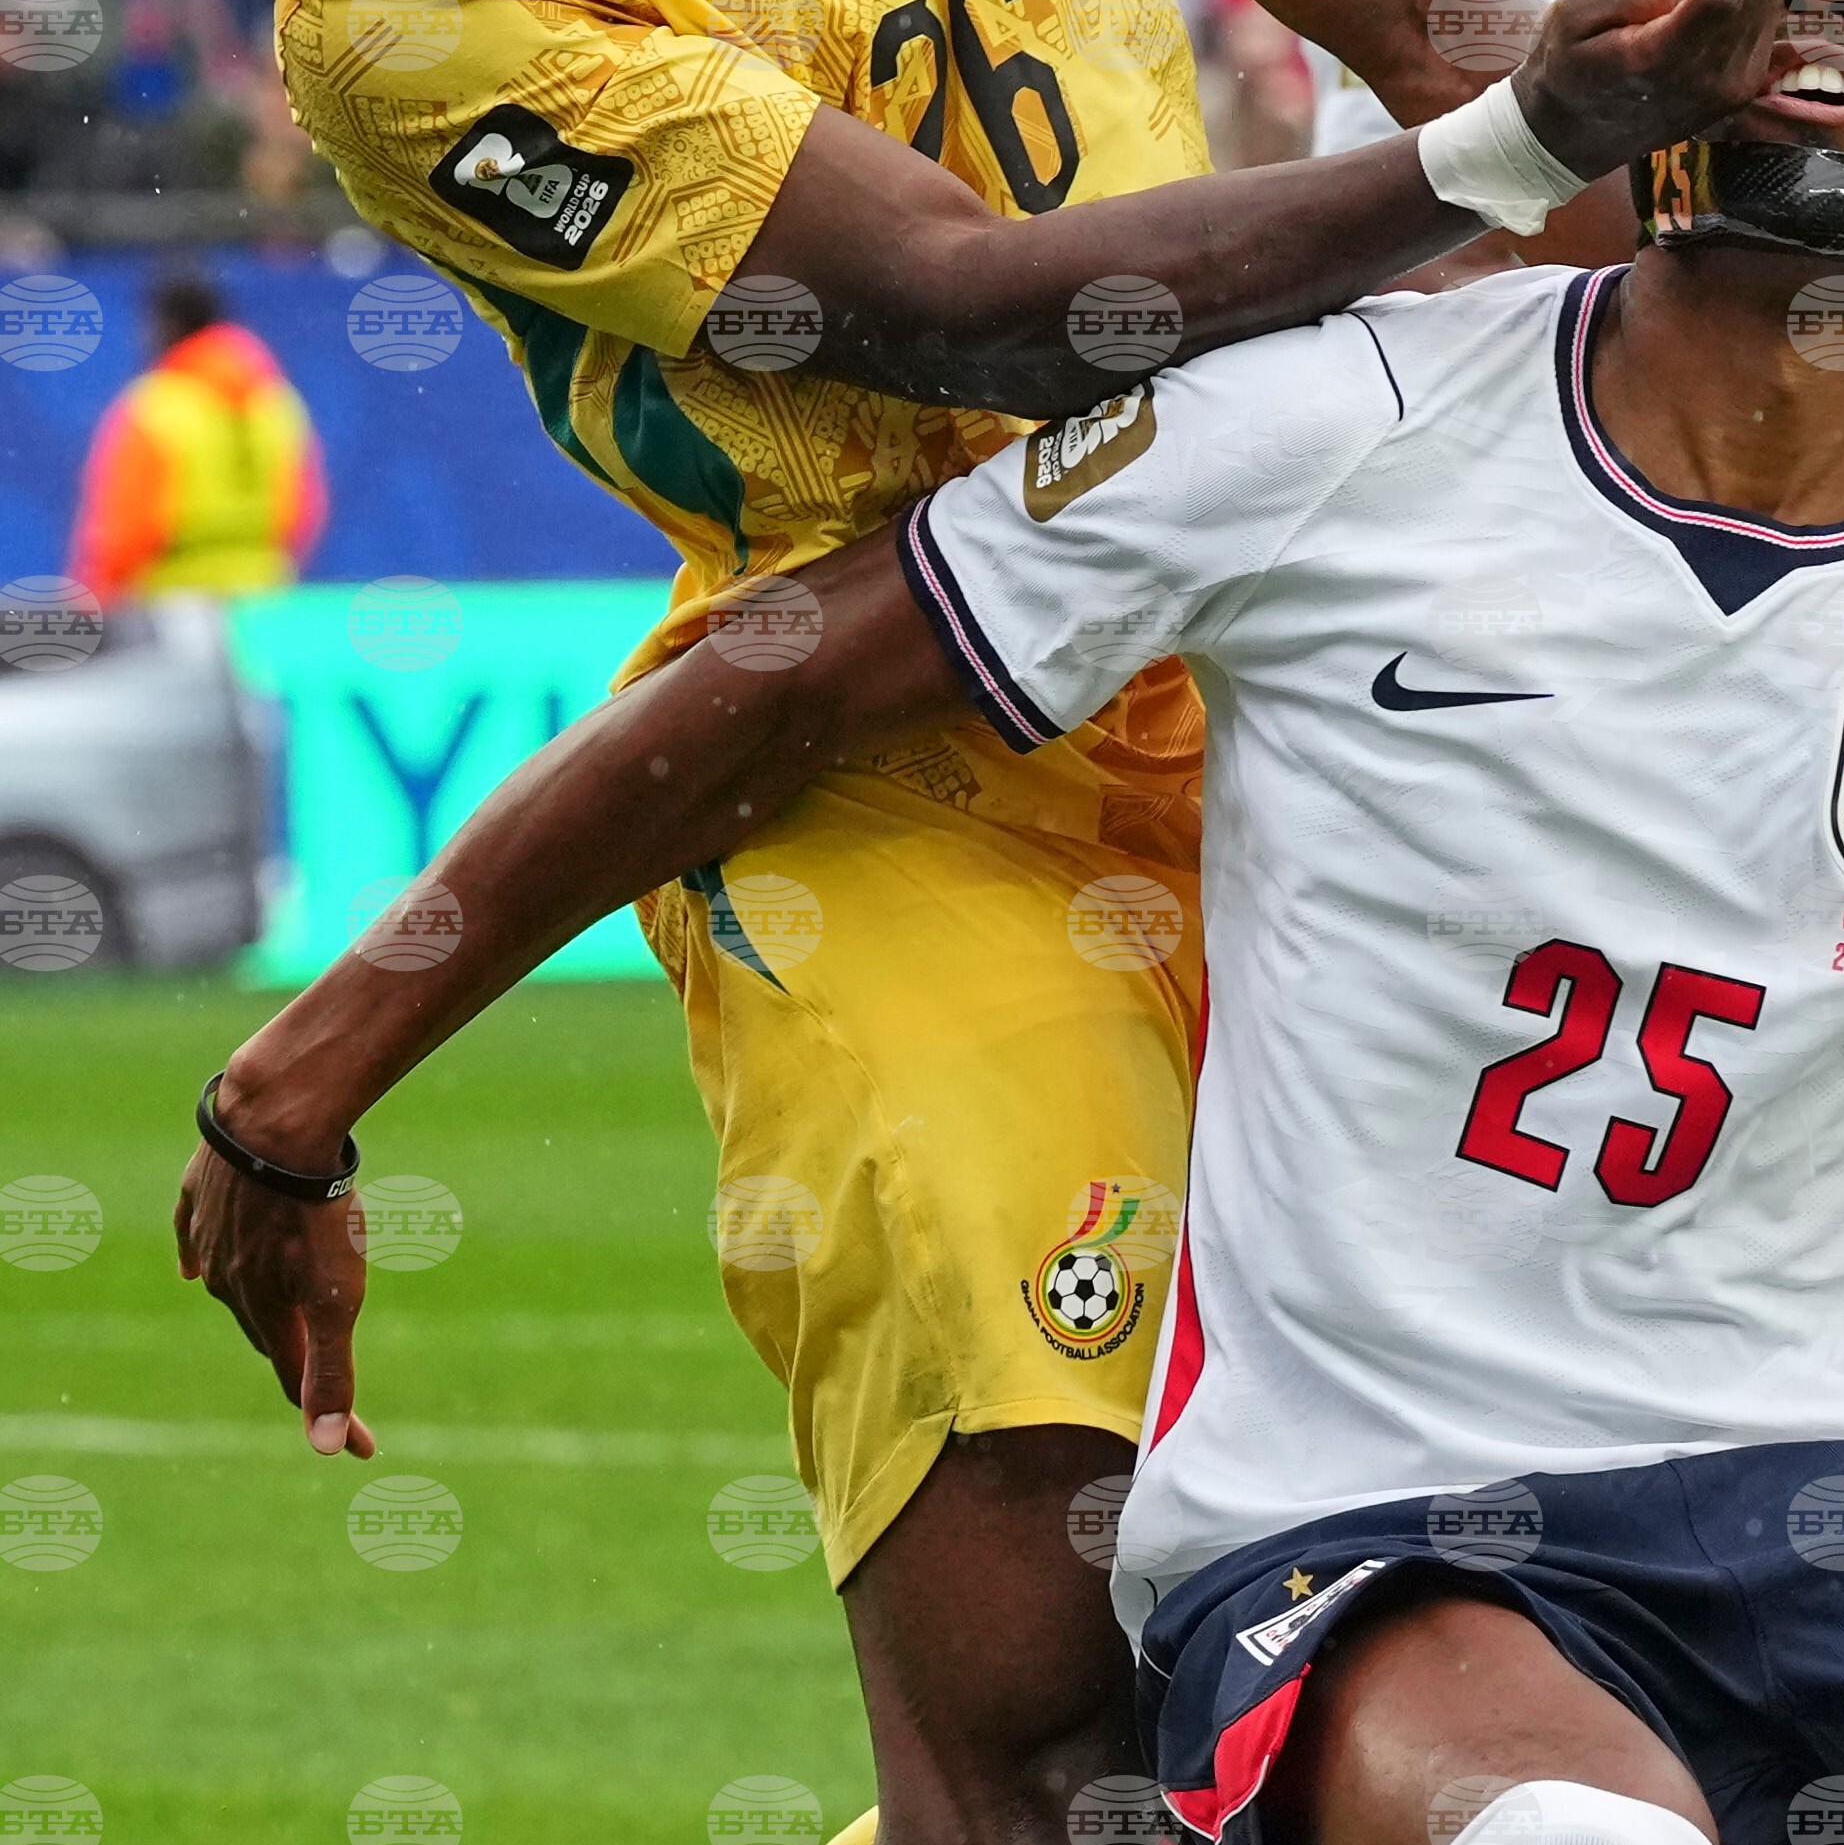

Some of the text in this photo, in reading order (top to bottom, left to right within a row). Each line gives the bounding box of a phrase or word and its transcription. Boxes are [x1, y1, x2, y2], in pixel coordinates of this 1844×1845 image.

[539, 178, 560, 204] FIFA
[553, 173, 591, 233] WORLD CUP
[564, 180, 609, 246] 2026
[1036, 435, 1055, 489] 2026
[1455, 938, 1767, 1208] 25
[1020, 1279, 1145, 1360] GHANA FOOTBALL ASSOCIATION
